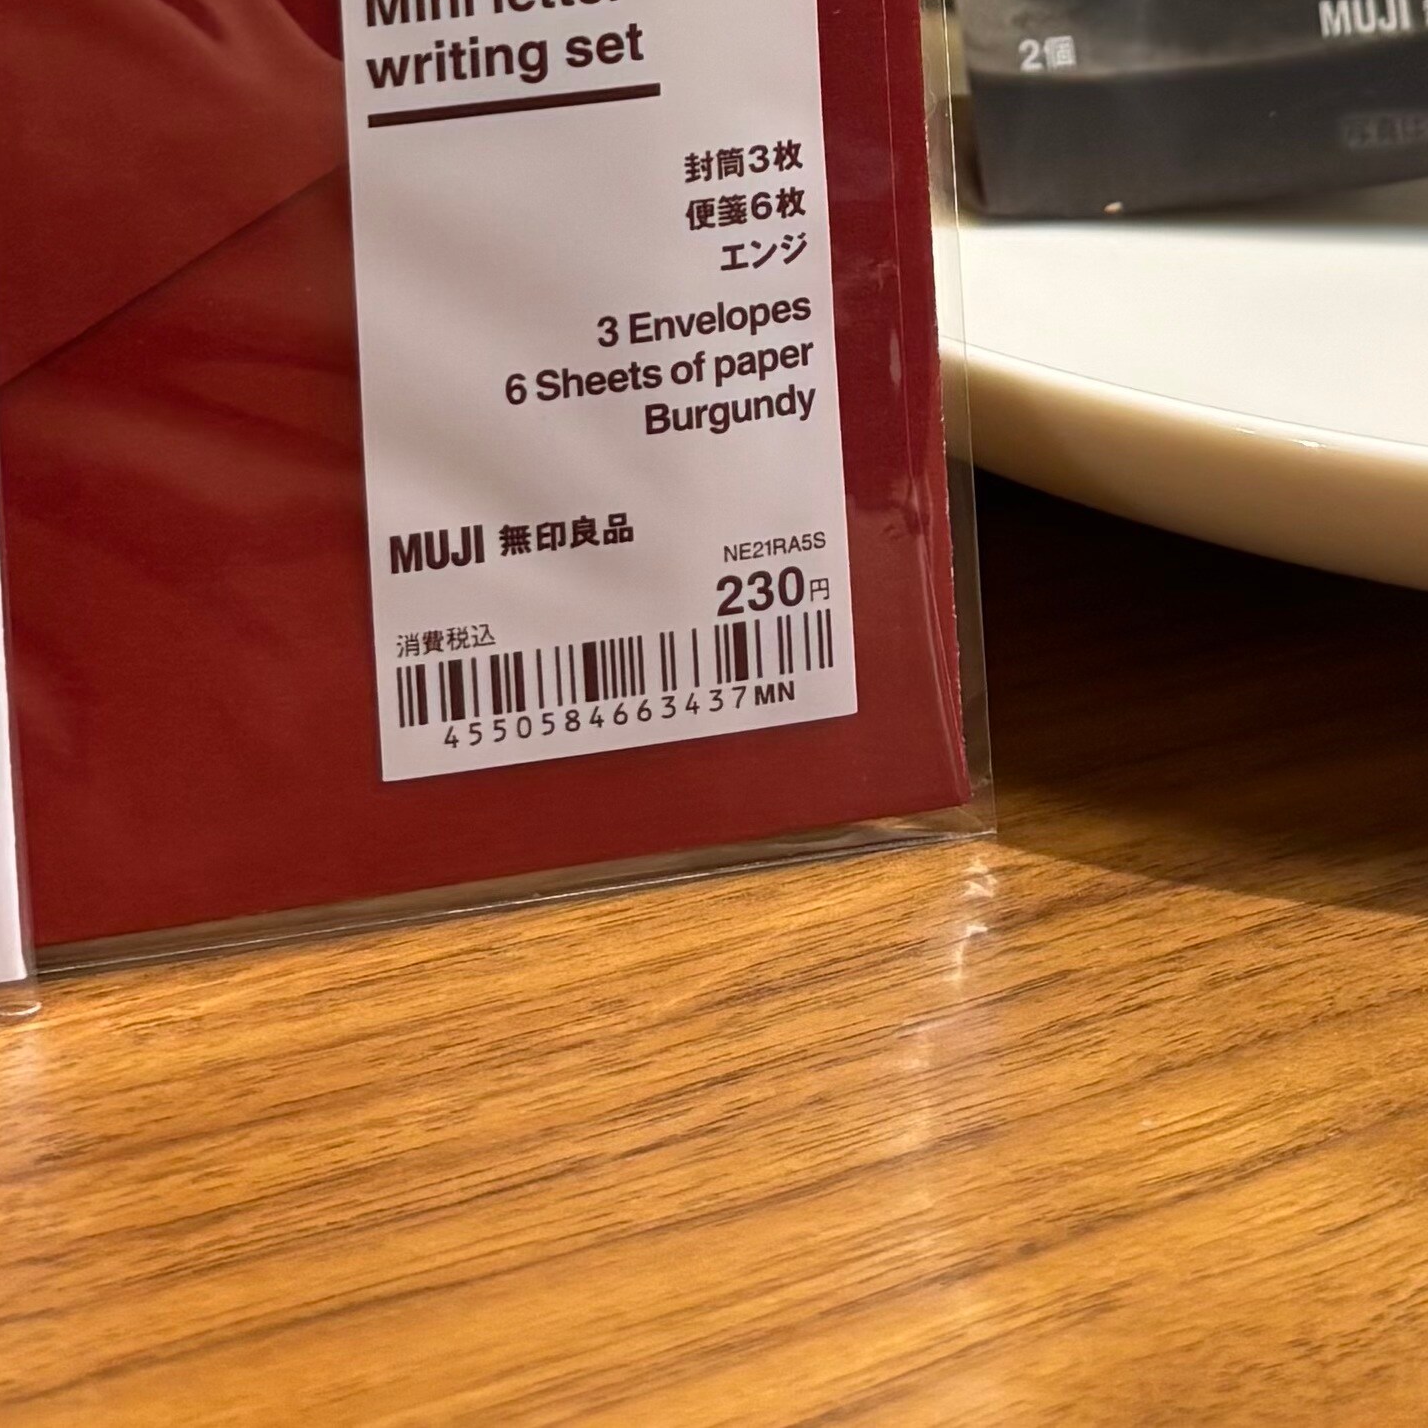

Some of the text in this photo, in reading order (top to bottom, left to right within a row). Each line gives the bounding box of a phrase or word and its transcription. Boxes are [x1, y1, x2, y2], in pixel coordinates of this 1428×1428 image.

[366, 23, 645, 89] writing set
[1018, 34, 1077, 72] 2個
[683, 139, 803, 184] 封筒3枚
[685, 186, 807, 231] 便箋6枚
[720, 232, 808, 272] エンジ
[597, 296, 812, 348] 3 Envelopes
[505, 341, 814, 406] 6 Sheets of paper
[645, 385, 816, 435] Burgundy
[389, 513, 635, 574] MUJI 無印良品
[723, 531, 827, 563] NE21RA5S
[716, 566, 831, 617] 230円
[396, 624, 497, 658] 消費税込
